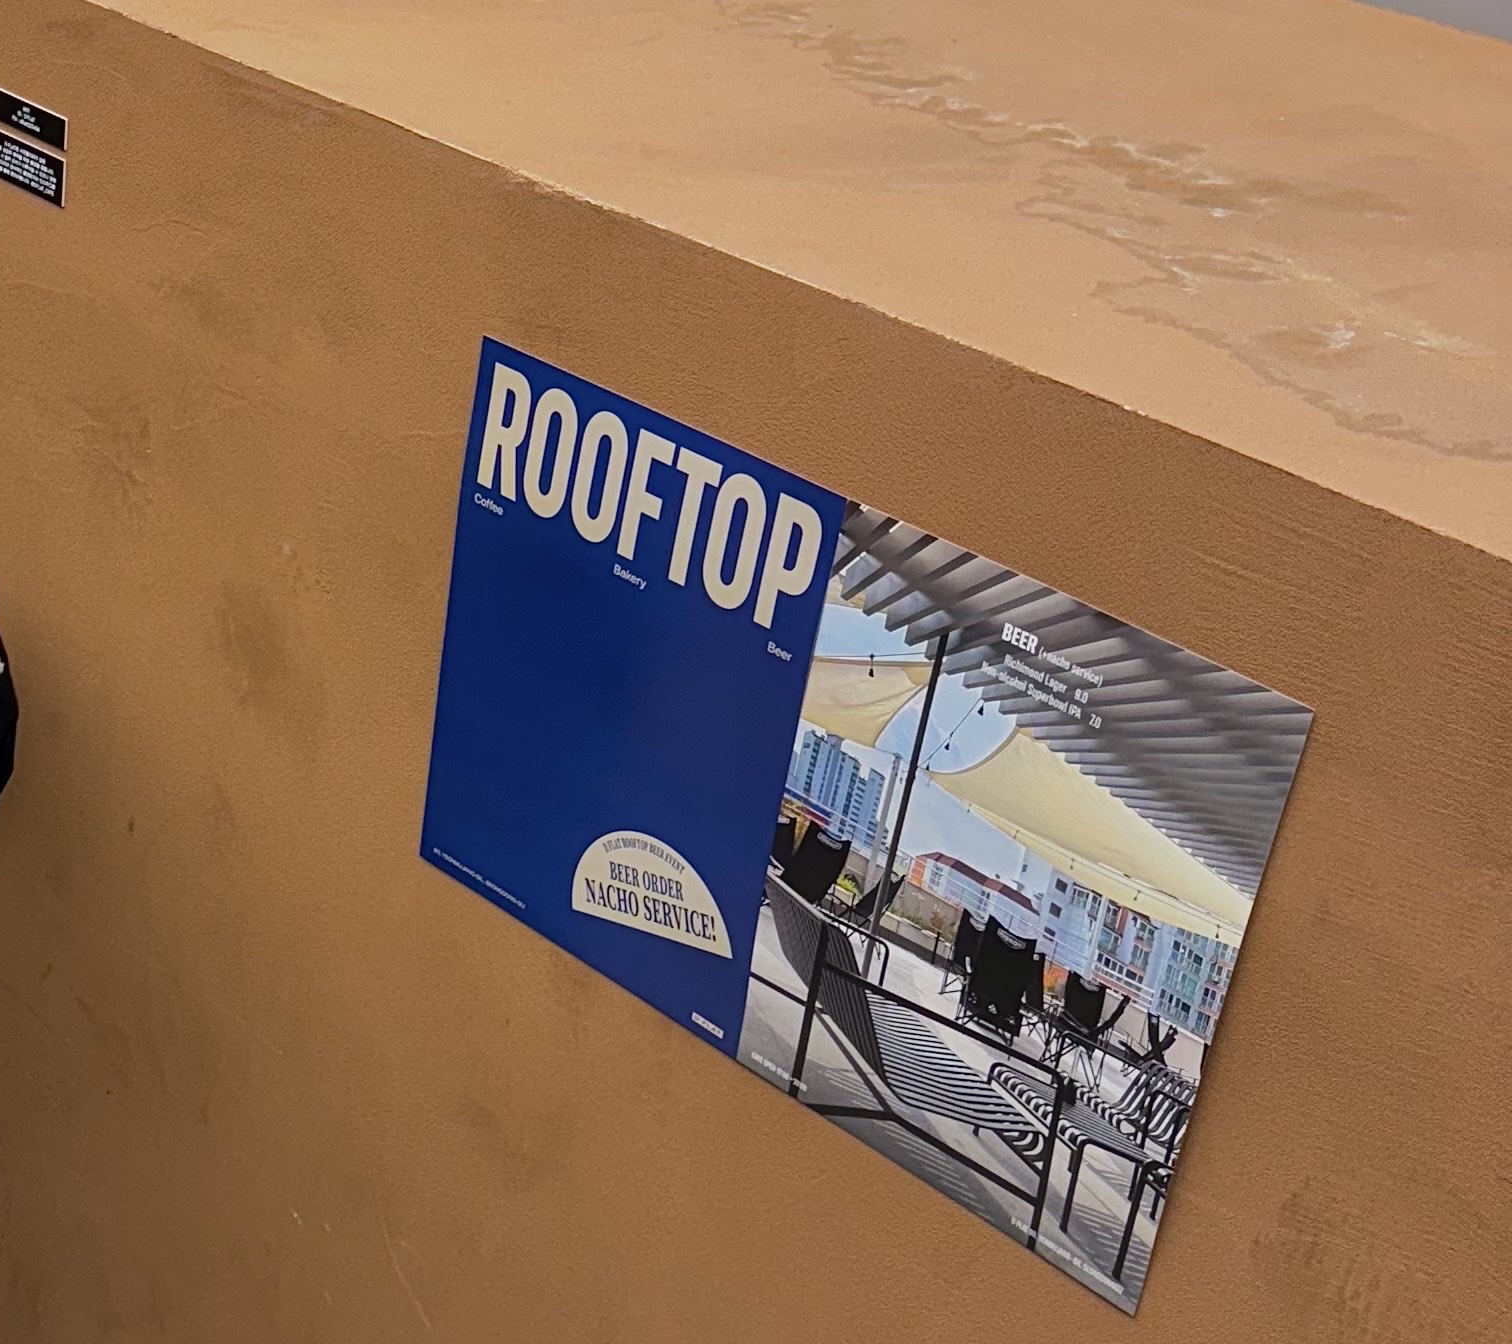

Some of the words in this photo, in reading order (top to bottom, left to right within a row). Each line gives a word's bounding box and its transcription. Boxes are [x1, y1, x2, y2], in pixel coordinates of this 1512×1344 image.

[474, 493, 504, 516] Coffee
[477, 362, 822, 629] ROOFTOP
[613, 564, 647, 590] Bakery
[767, 641, 792, 662] Beer
[1001, 622, 1038, 654] BEER
[1044, 673, 1068, 694] Lager
[1067, 703, 1082, 719] IPA
[649, 843, 665, 859] BEER
[664, 853, 686, 874] EVENT
[609, 861, 640, 888] BEER
[642, 870, 684, 902] ORDER
[584, 877, 639, 918] NACHO
[643, 895, 717, 942] SERVICE!
